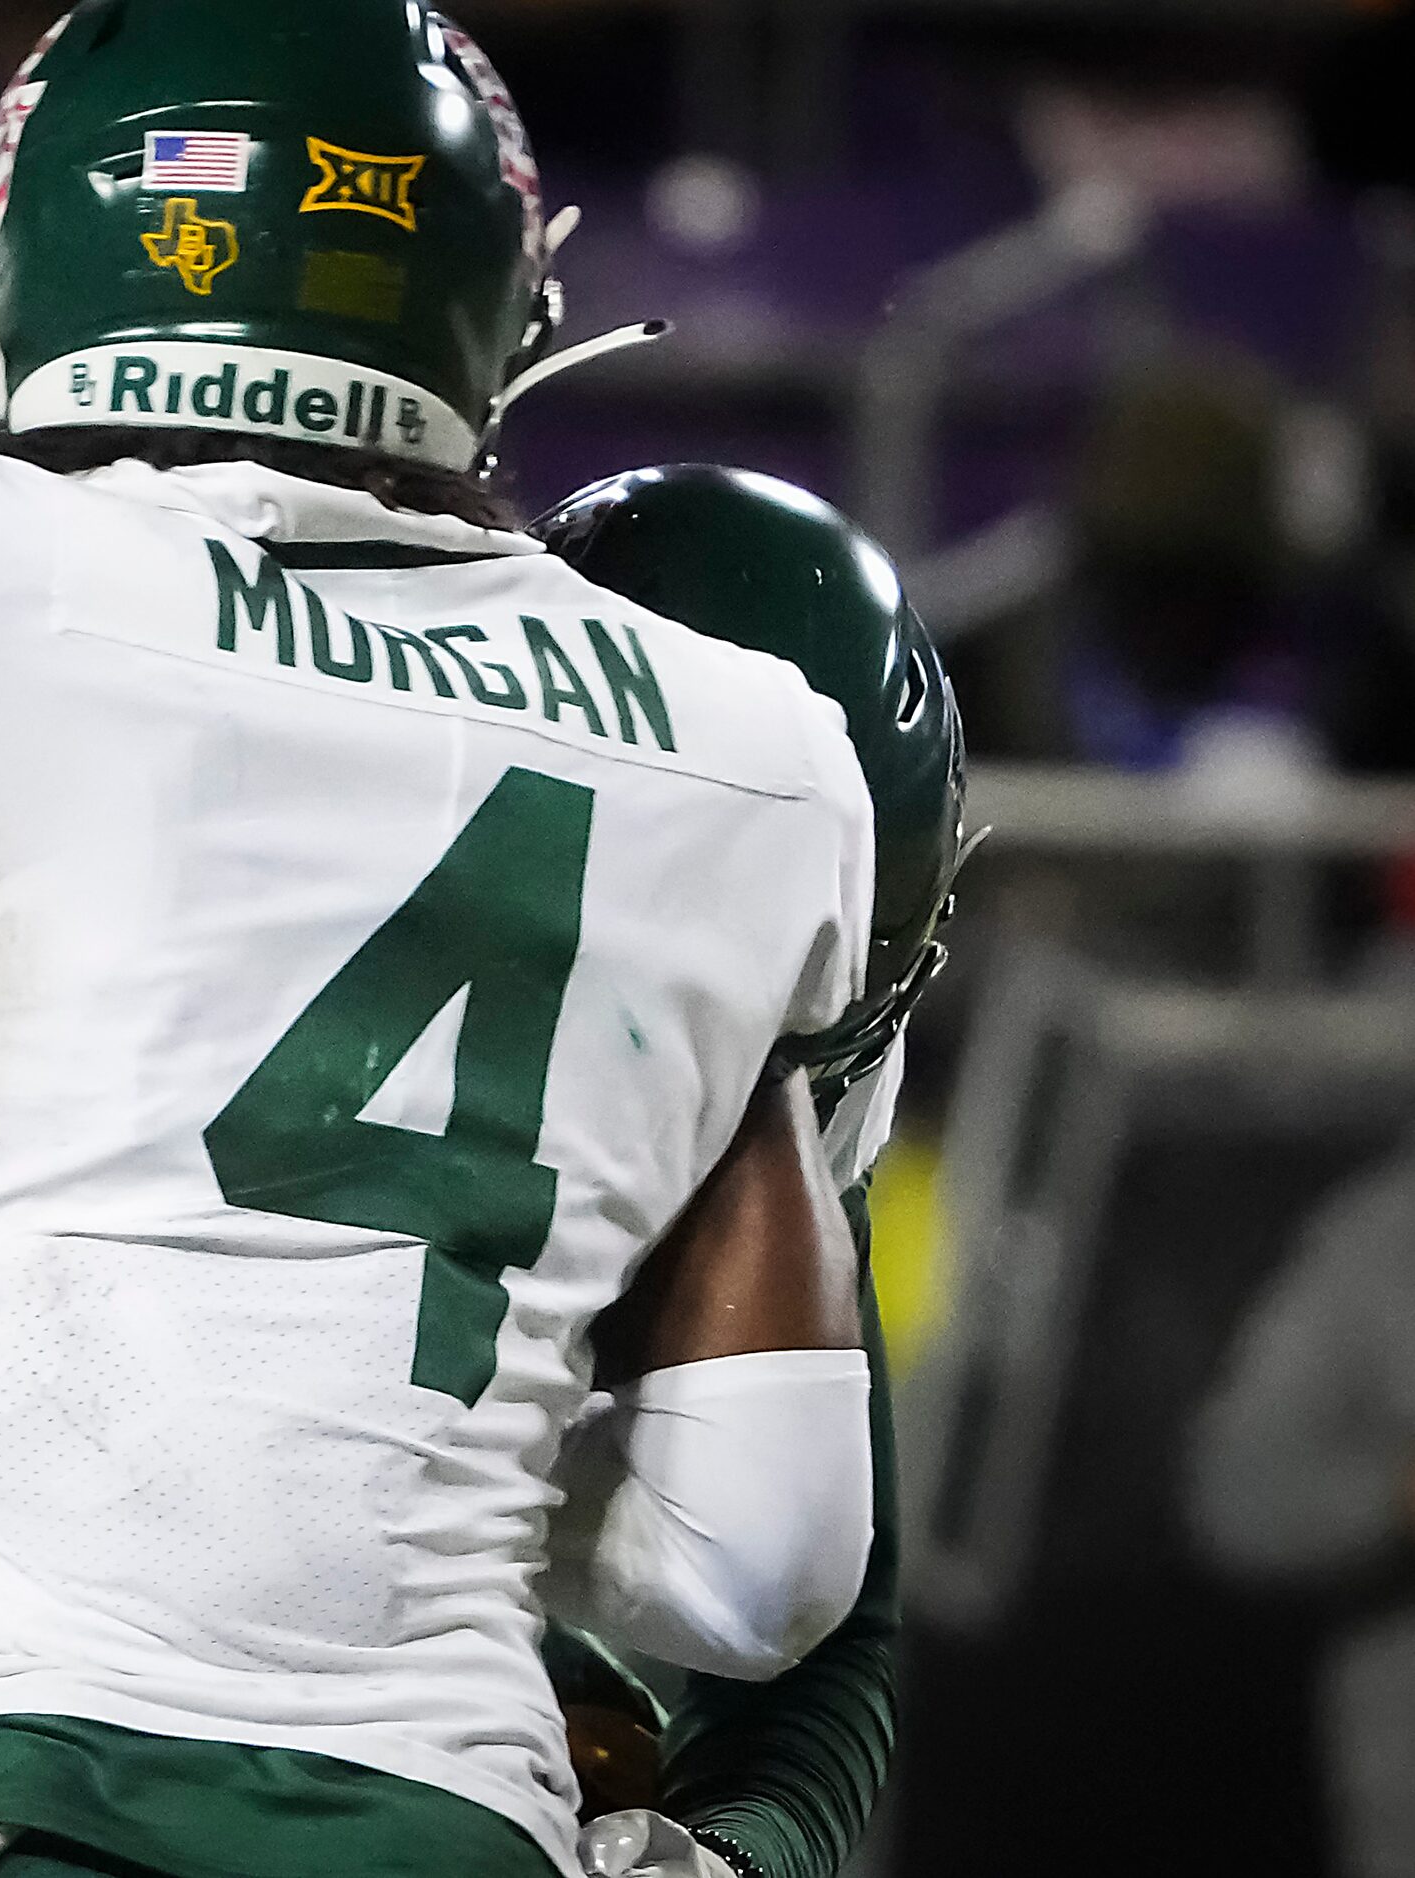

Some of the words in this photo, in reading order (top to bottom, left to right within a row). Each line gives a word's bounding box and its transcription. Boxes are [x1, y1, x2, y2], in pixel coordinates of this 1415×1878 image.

[110, 356, 386, 441] Riddell
[204, 538, 678, 753] MORGAN
[203, 765, 595, 1410] 4
